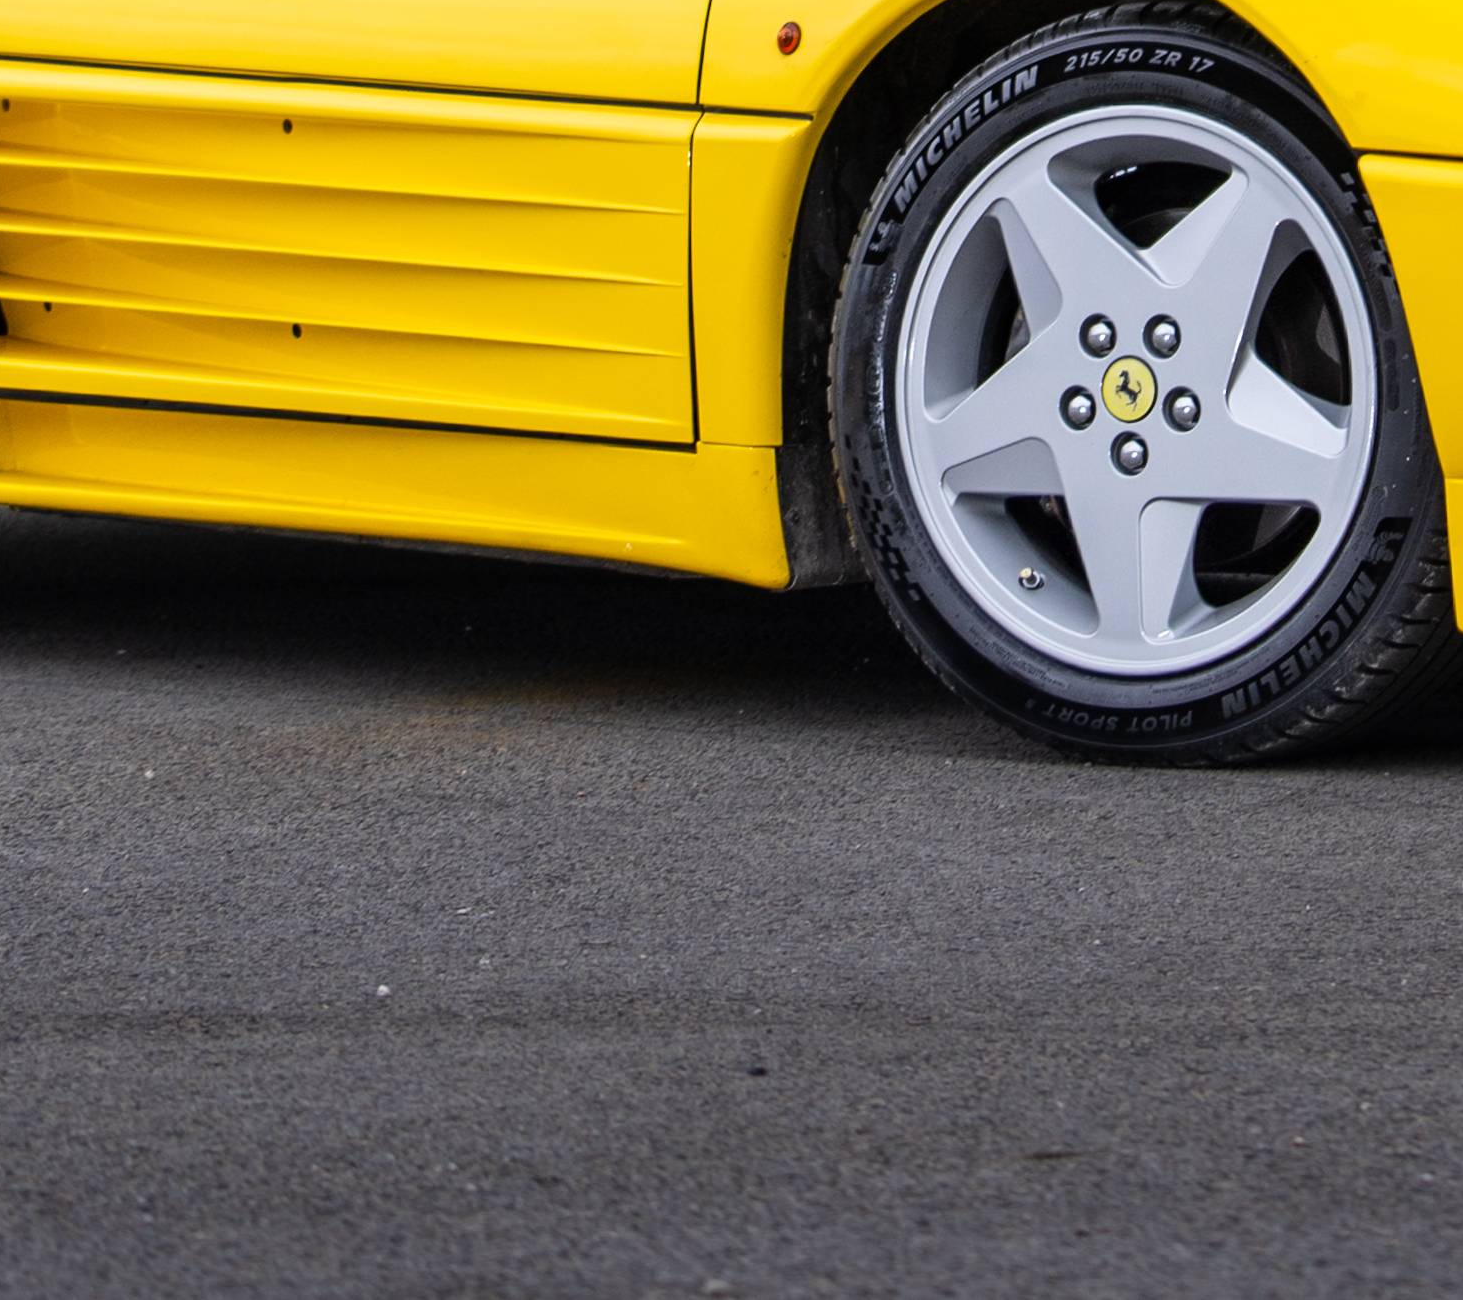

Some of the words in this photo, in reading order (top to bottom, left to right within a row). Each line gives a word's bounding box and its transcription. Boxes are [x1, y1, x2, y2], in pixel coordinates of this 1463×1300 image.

[894, 64, 1038, 213] MICHELIN
[1063, 47, 1143, 73] 215/50
[1149, 49, 1181, 67] ZR
[1188, 55, 1215, 74] 17
[1220, 569, 1377, 720] MICHELIN
[1041, 703, 1120, 731] SPORT
[1127, 710, 1194, 733] PILOT
